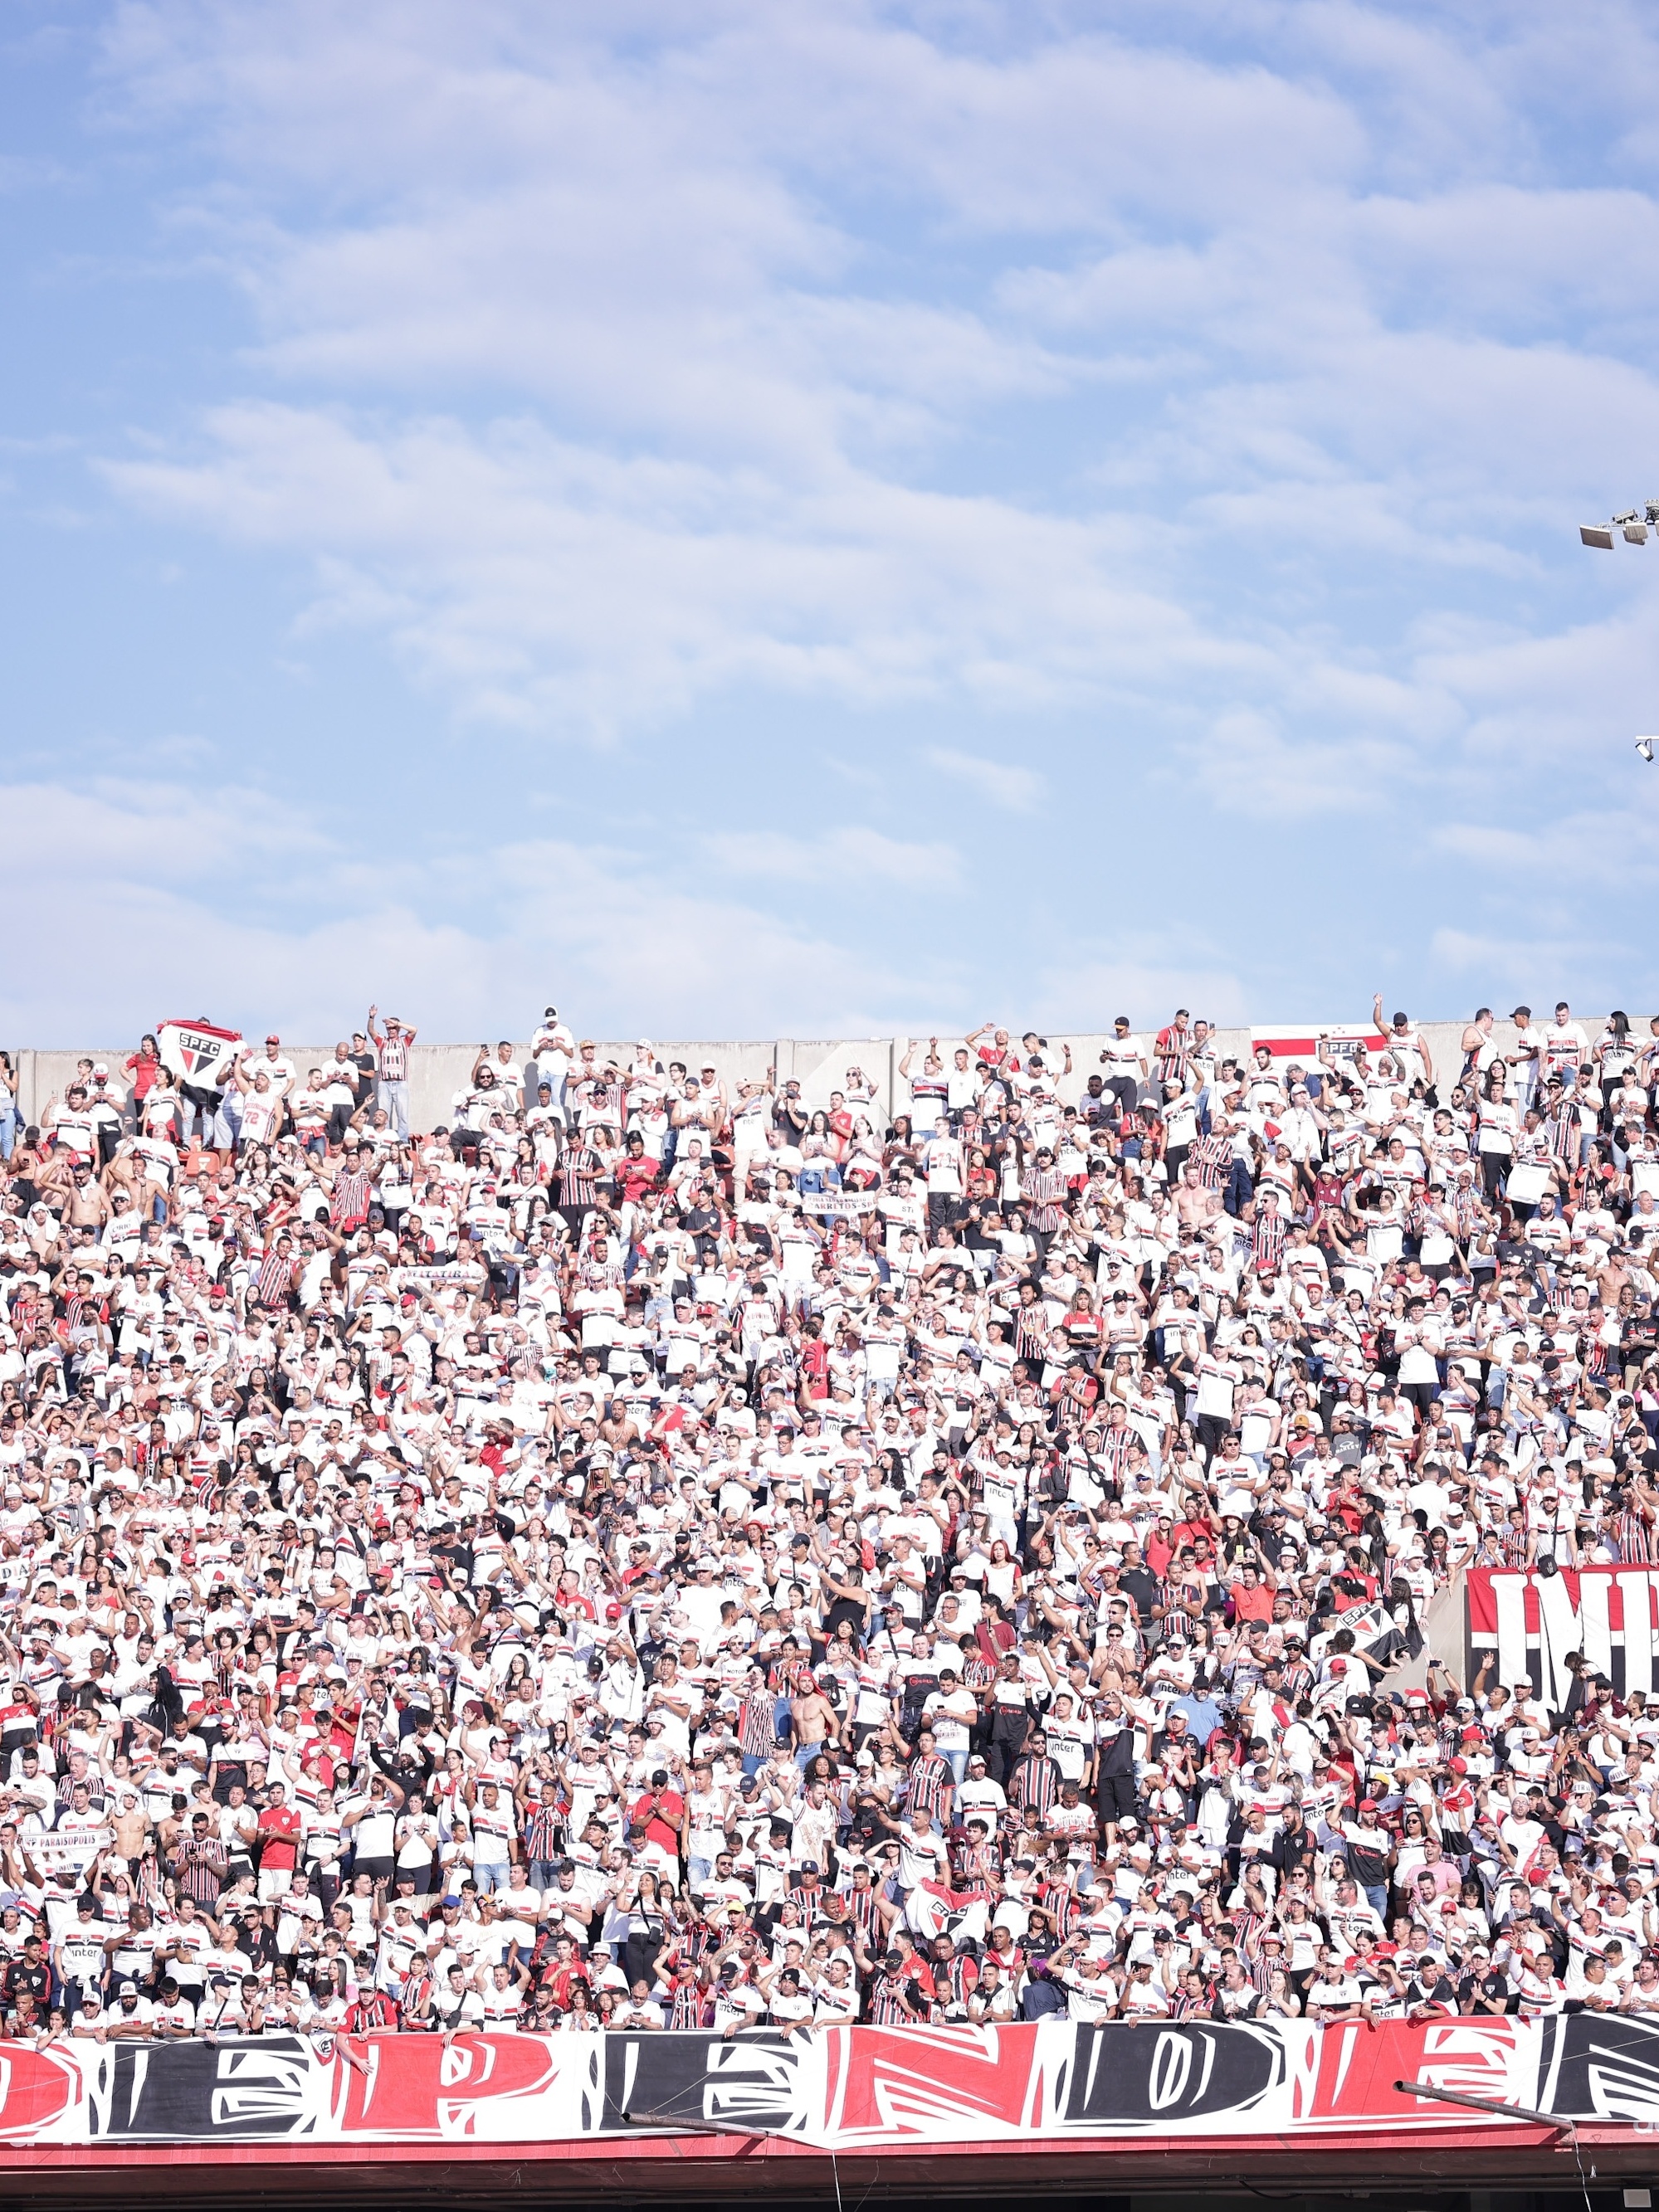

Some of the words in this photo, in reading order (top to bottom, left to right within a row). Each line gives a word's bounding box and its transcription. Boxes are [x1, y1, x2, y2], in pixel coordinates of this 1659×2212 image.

[180, 1033, 222, 1056] SPFC
[246, 1111, 259, 1125] 72
[626, 1406, 645, 1415] nter
[1159, 1682, 1182, 1695] inter
[41, 1834, 96, 1848] PARAISOPOLIS
[72, 1947, 98, 1956] inter
[719, 2002, 741, 2016] inter
